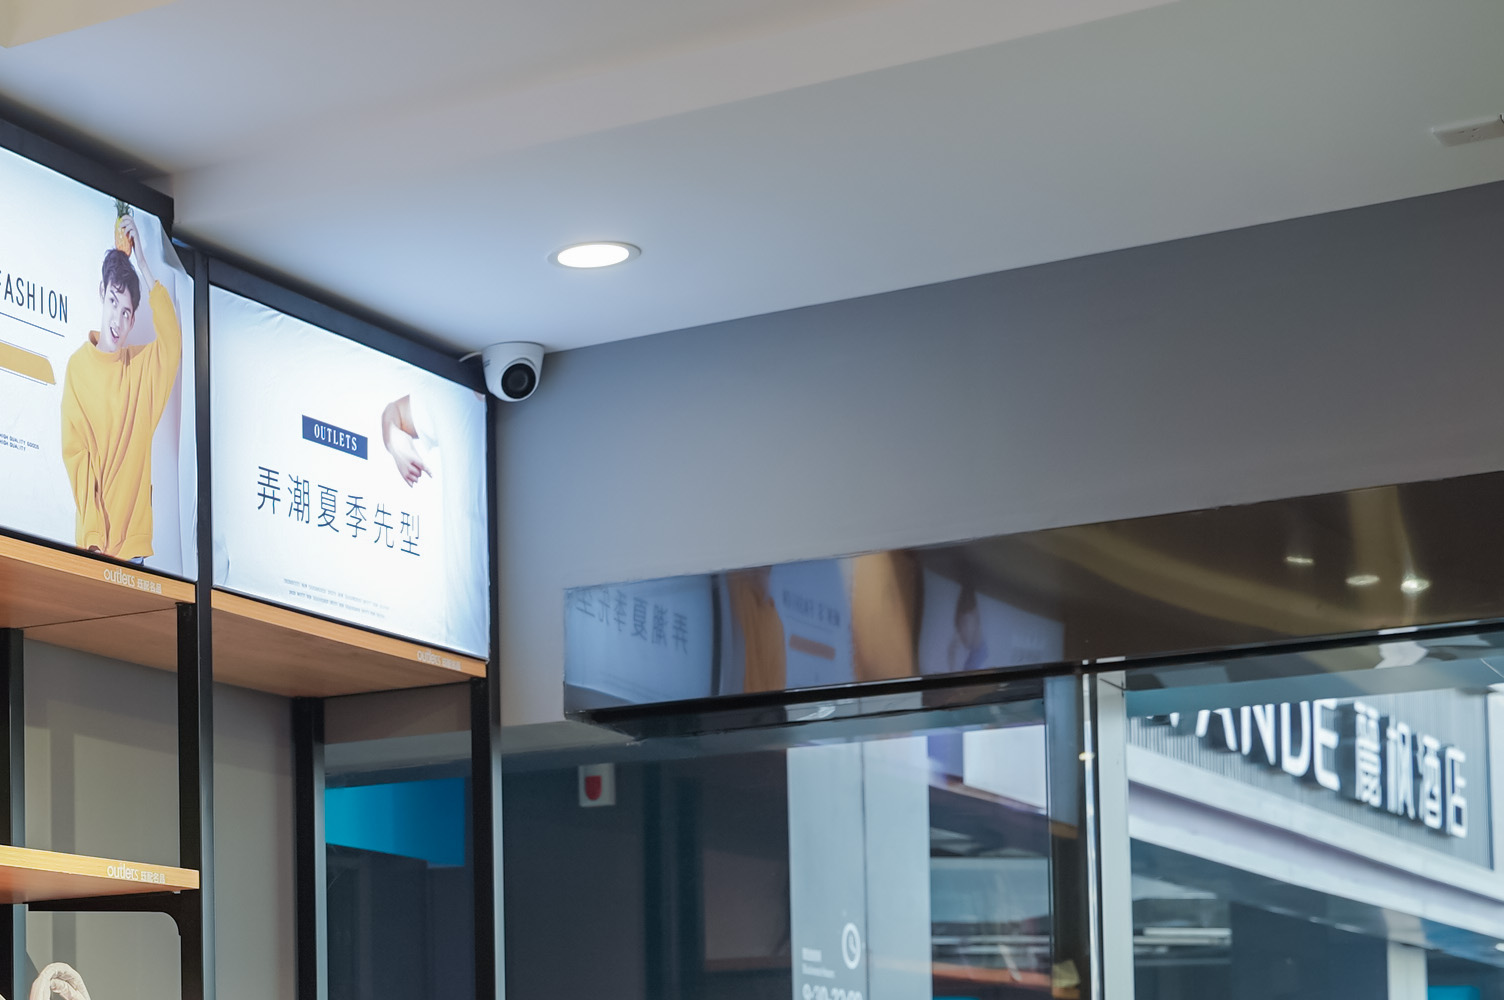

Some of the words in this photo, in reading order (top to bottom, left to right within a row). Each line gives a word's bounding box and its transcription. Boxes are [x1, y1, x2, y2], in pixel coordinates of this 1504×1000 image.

[313, 423, 358, 452] OUTLETS
[256, 465, 421, 557] 弄潮夏季先型
